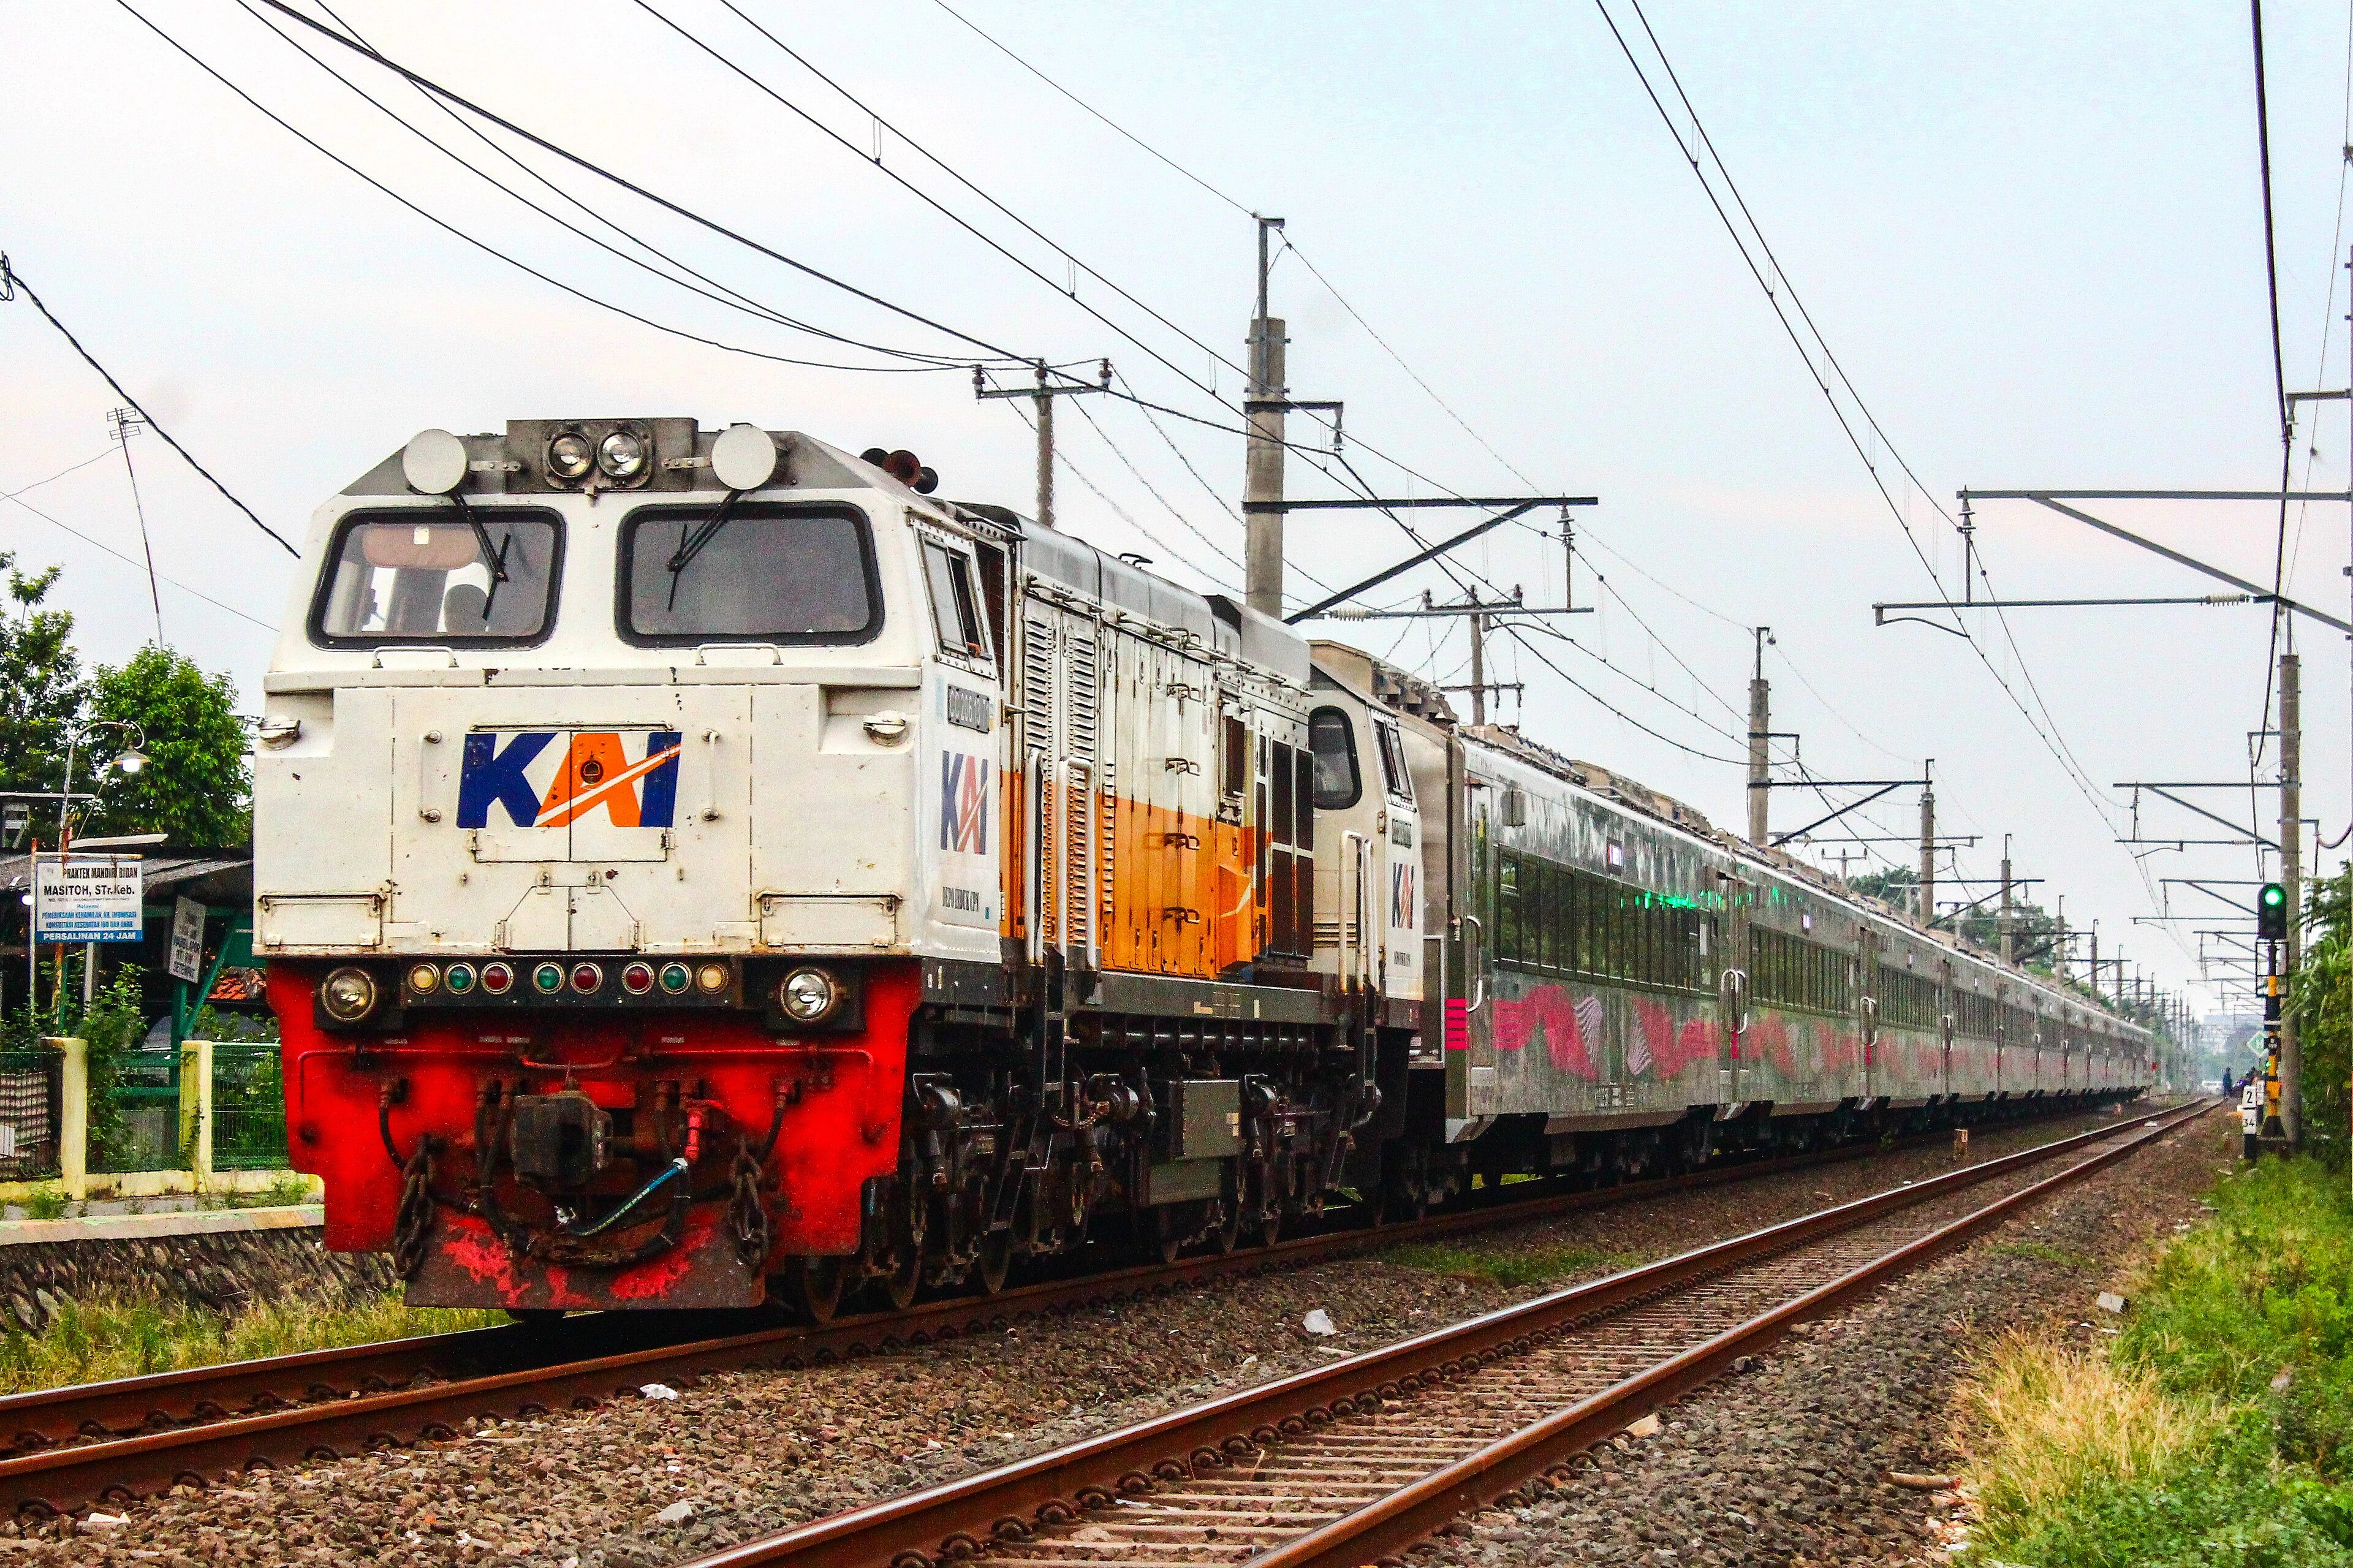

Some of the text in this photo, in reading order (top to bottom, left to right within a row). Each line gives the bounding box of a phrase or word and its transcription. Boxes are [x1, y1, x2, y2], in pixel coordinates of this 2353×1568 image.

[456, 732, 683, 828] KAI
[941, 750, 988, 855] KAI
[44, 885, 91, 896] MASITOH,
[63, 868, 90, 879] PRAKTEK
[119, 867, 138, 878] BIDAN
[1392, 862, 1414, 929] KAI
[2246, 1091, 2253, 1104] 2
